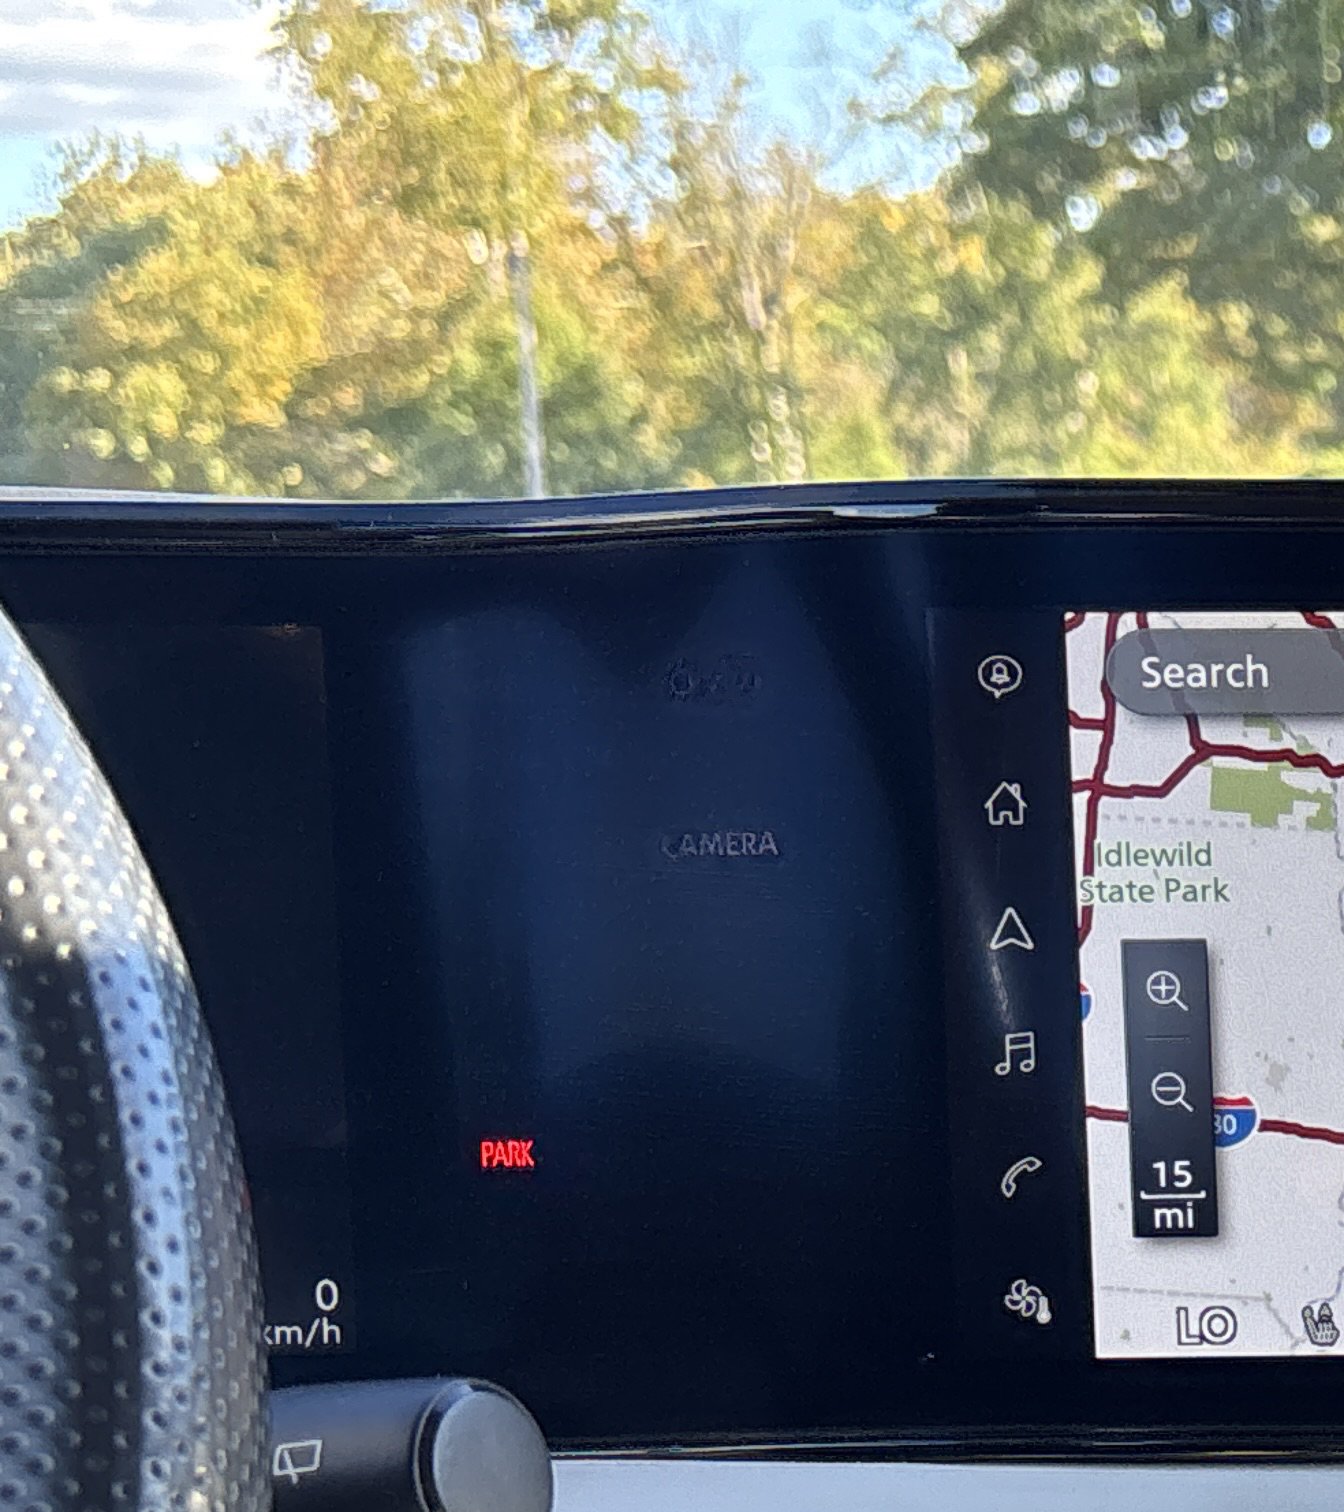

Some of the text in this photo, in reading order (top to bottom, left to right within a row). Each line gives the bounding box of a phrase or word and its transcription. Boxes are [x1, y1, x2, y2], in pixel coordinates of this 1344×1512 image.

[1141, 654, 1269, 689] Search
[661, 831, 779, 860] CAMERA
[1097, 841, 1213, 867] Idlewild
[1080, 877, 1229, 902] State Park
[481, 1140, 535, 1168] PARK
[1152, 1160, 1193, 1187] 15
[1154, 1202, 1195, 1229] mi
[315, 1278, 339, 1311] 0
[1176, 1305, 1238, 1346] LO
